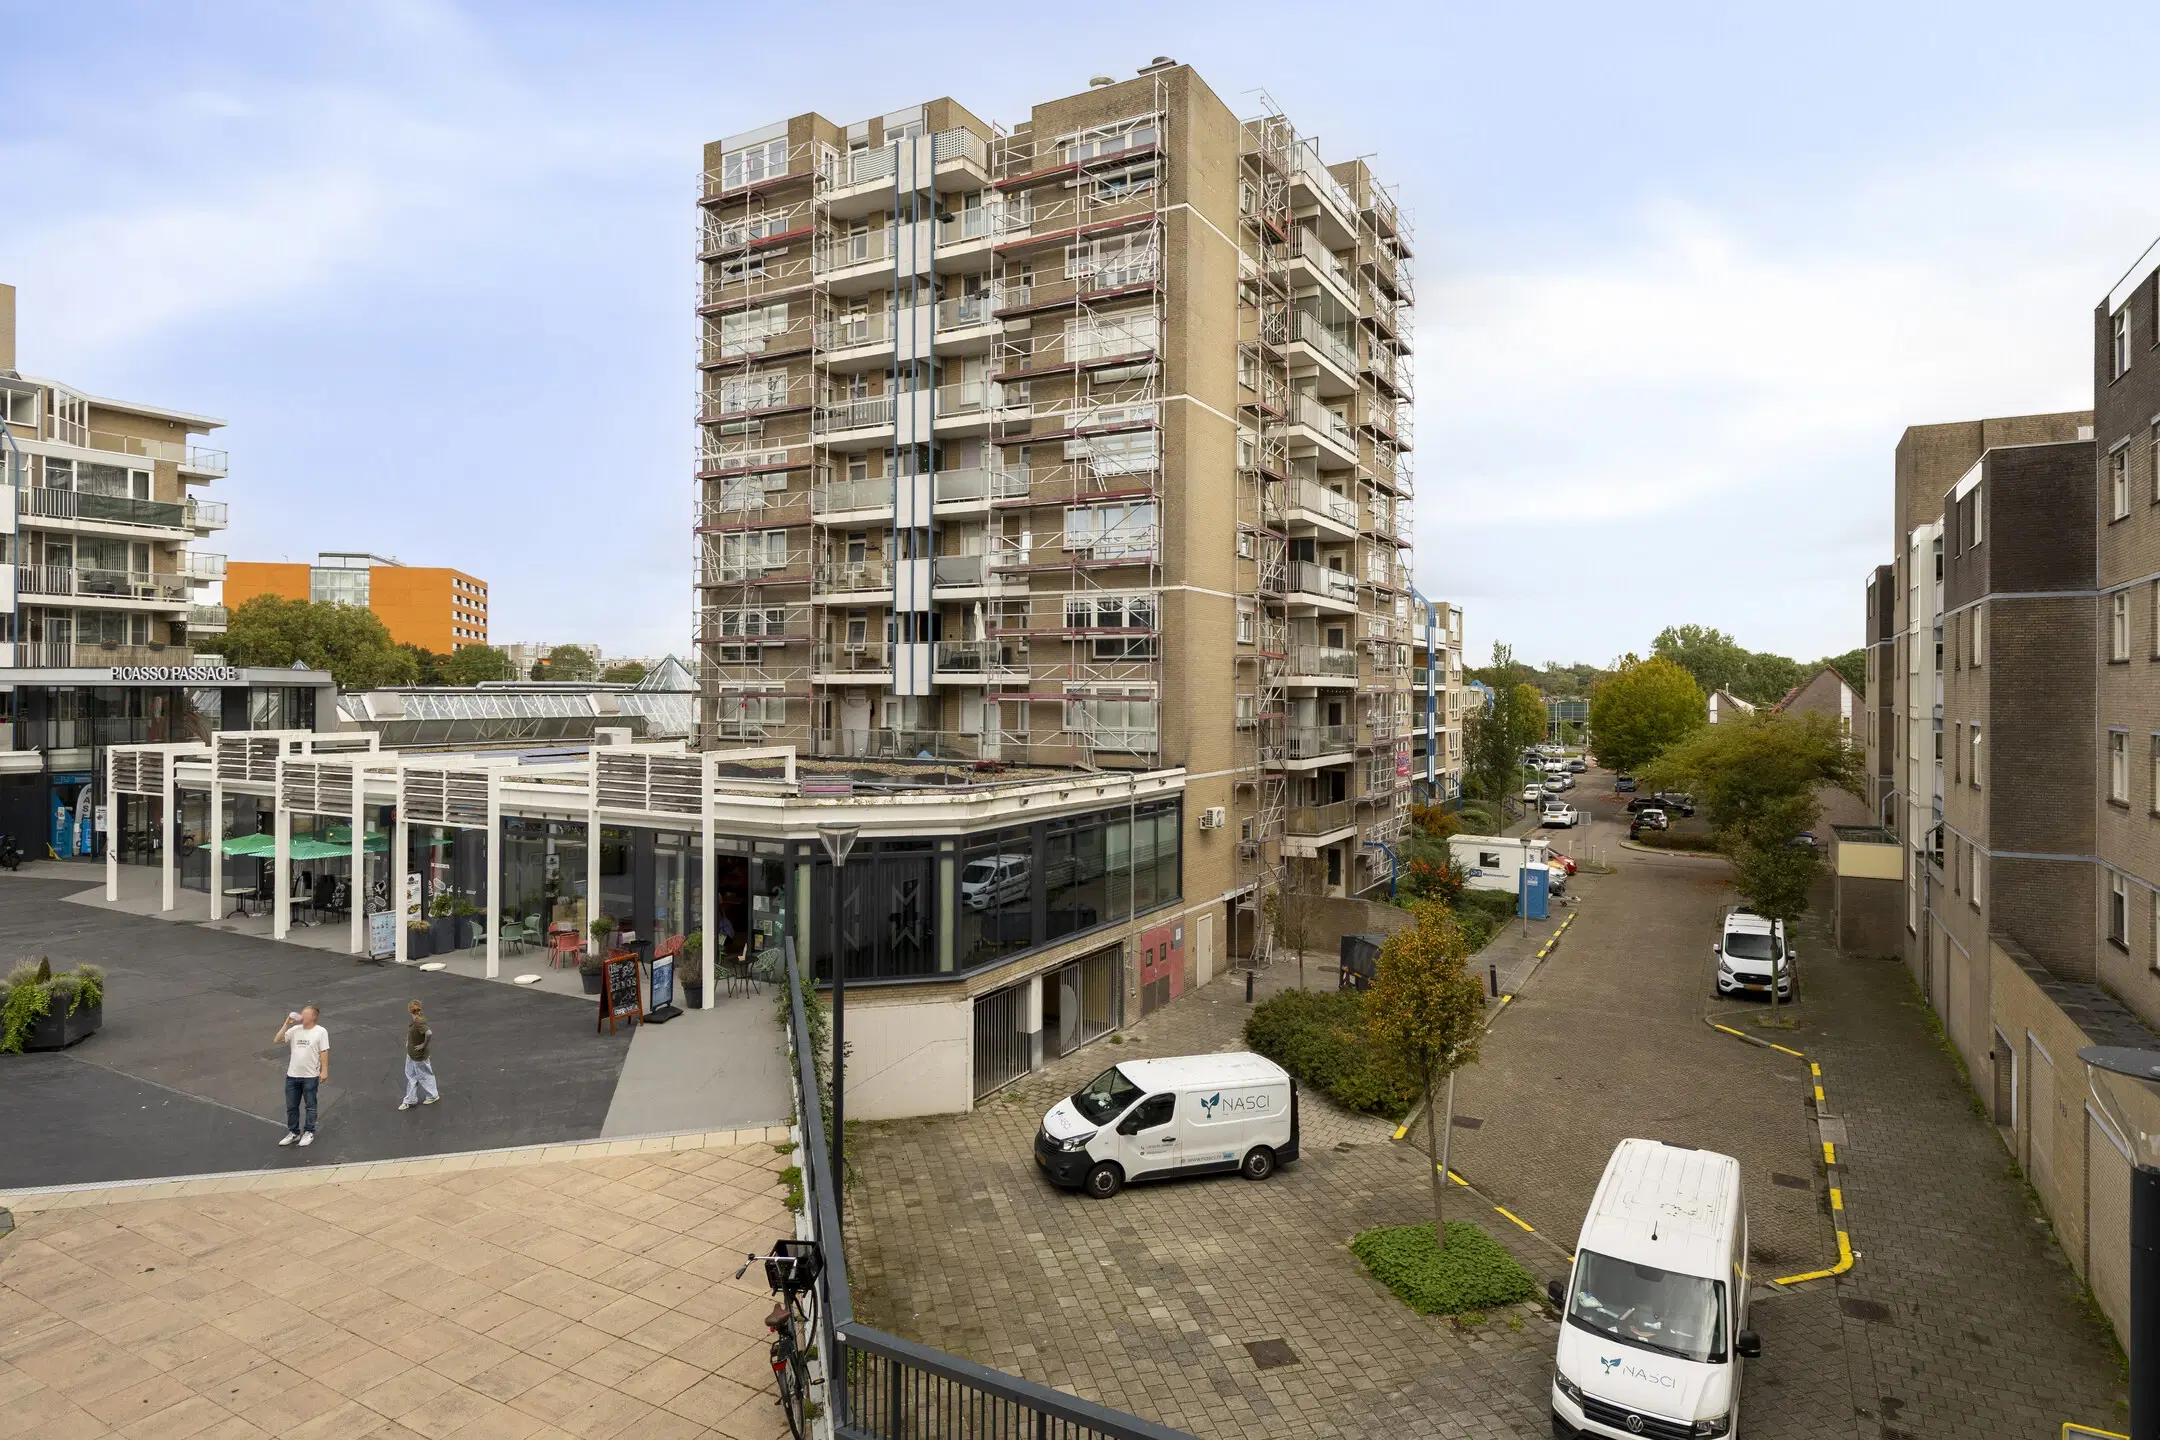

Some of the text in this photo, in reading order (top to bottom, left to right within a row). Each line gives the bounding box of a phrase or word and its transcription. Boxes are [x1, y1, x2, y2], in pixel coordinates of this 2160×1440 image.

[111, 666, 236, 680] PICASSO PASSAGE
[1222, 1094, 1270, 1112] NASCI
[1622, 1365, 1676, 1389] NASCI
